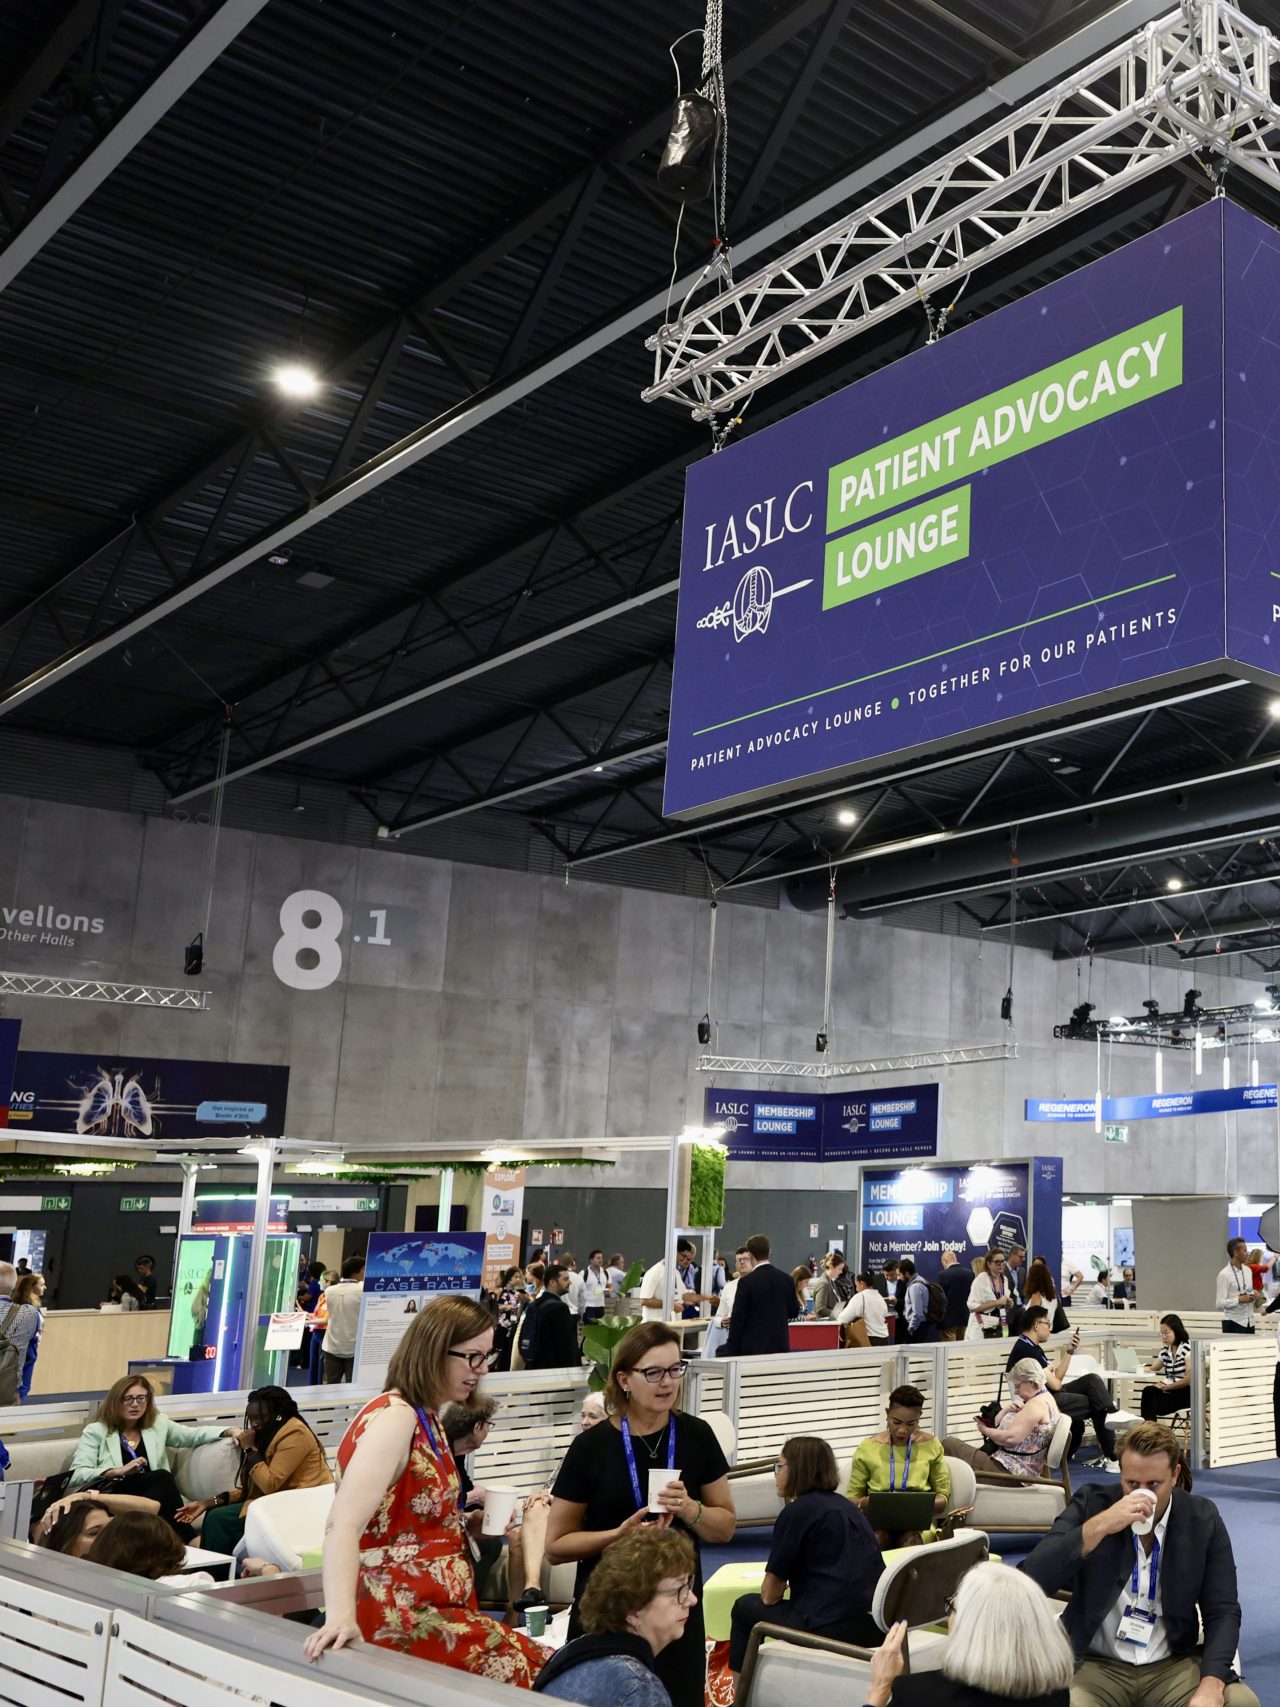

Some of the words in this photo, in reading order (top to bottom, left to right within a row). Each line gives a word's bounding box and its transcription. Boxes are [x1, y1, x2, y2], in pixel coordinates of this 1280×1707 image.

[840, 427, 960, 513] PATIENT
[969, 333, 1167, 458] ADVOCACY
[703, 481, 814, 572] IASLC
[837, 505, 959, 587] LOUNGE
[691, 744, 742, 772] PATIENT
[748, 722, 818, 754] ADVOCACY
[825, 701, 882, 730] LOUNGE
[908, 667, 991, 705] TOGETHER
[1000, 654, 1032, 677] FOR
[1041, 641, 1075, 663] OUR
[1086, 608, 1177, 649] PATIENTS
[40, 932, 75, 947] Halls
[843, 1104, 866, 1116] IASLC
[872, 1101, 915, 1114] MEMBERSHIP
[1152, 1096, 1193, 1108] REGENERON
[715, 1102, 748, 1115] IASLC
[757, 1106, 814, 1118] MEMBERSHIP
[756, 1122, 793, 1132] LOUNGE
[871, 1118, 899, 1129] LOUNGE
[869, 1210, 918, 1227] LOUNGE
[869, 1241, 882, 1251] Not
[883, 1243, 888, 1251] a
[889, 1241, 922, 1252] Member?
[922, 1241, 939, 1251] Join
[940, 1240, 966, 1253] Today!
[374, 1282, 420, 1291] CASE
[426, 1280, 471, 1290] RACE
